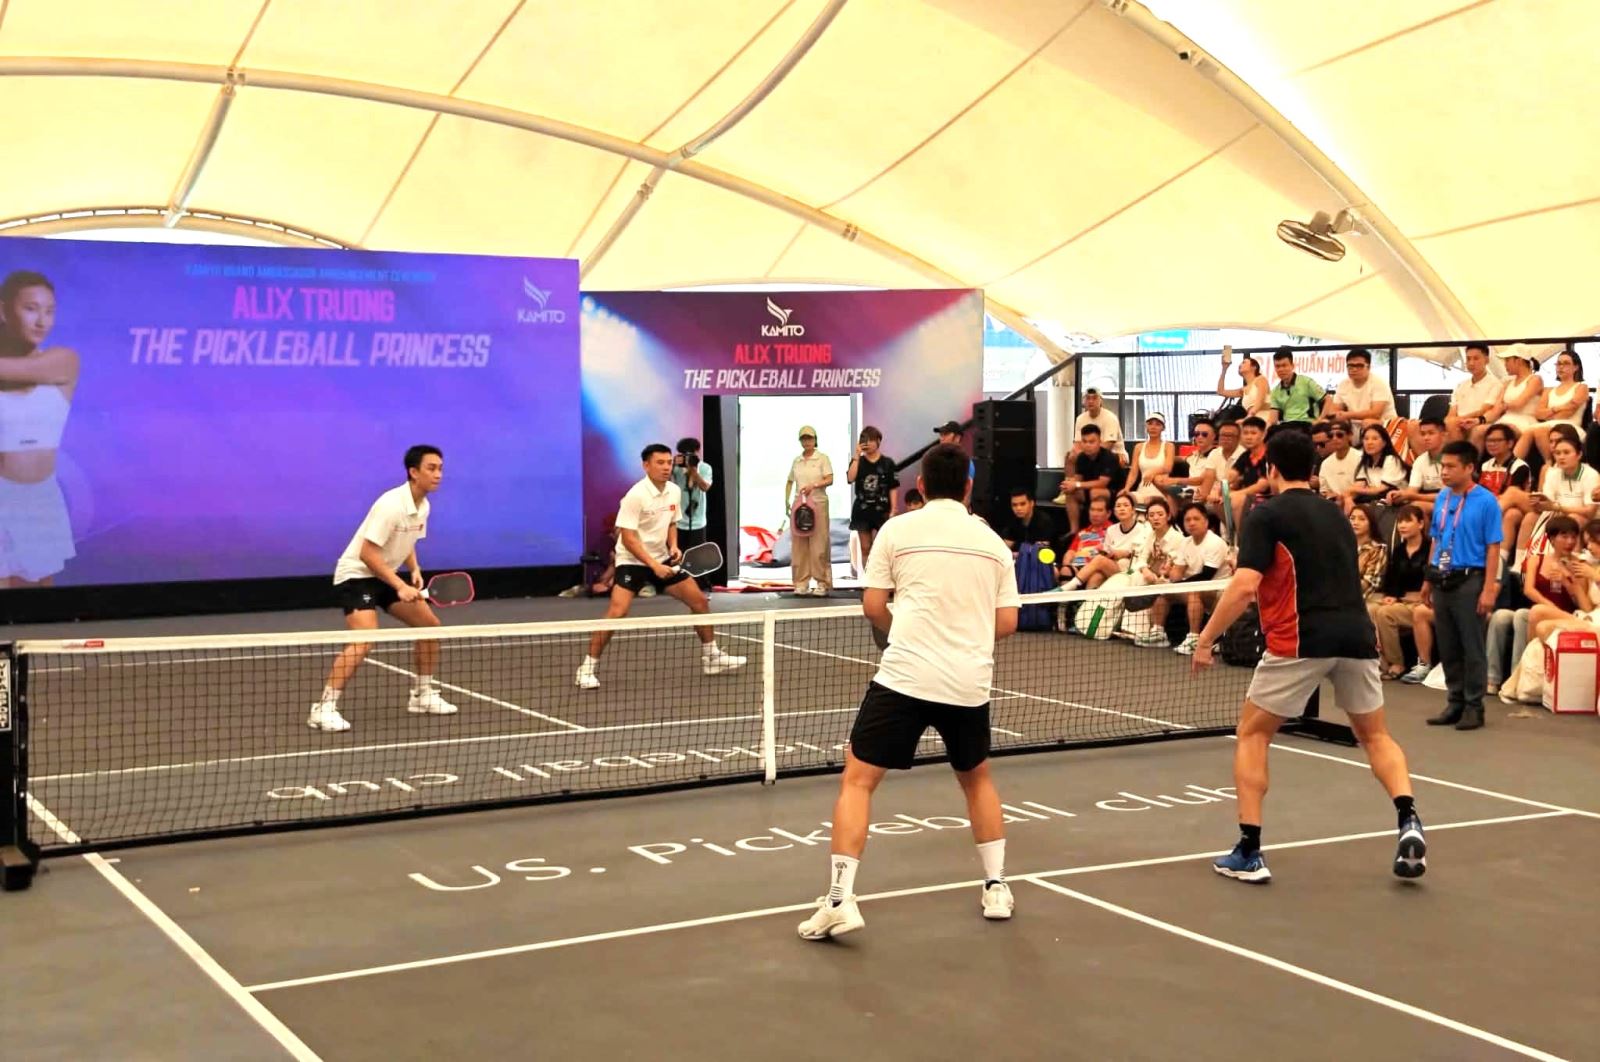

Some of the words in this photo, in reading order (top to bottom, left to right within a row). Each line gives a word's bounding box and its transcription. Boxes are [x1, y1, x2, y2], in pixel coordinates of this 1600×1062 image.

[233, 286, 294, 320] ALIX
[300, 287, 394, 322] TRUONG
[517, 309, 565, 323] KAMITO
[761, 325, 804, 337] KAMITO
[129, 328, 187, 365] THE
[193, 328, 360, 366] PICKLEBALL
[370, 332, 491, 367] PRINCESS
[734, 344, 770, 364] ALIX
[774, 344, 832, 364] TRUONG
[684, 369, 713, 389] THE
[716, 369, 806, 389] PICKLEBALL
[811, 368, 881, 388] PRINCESS
[627, 801, 1077, 865] Pickebll
